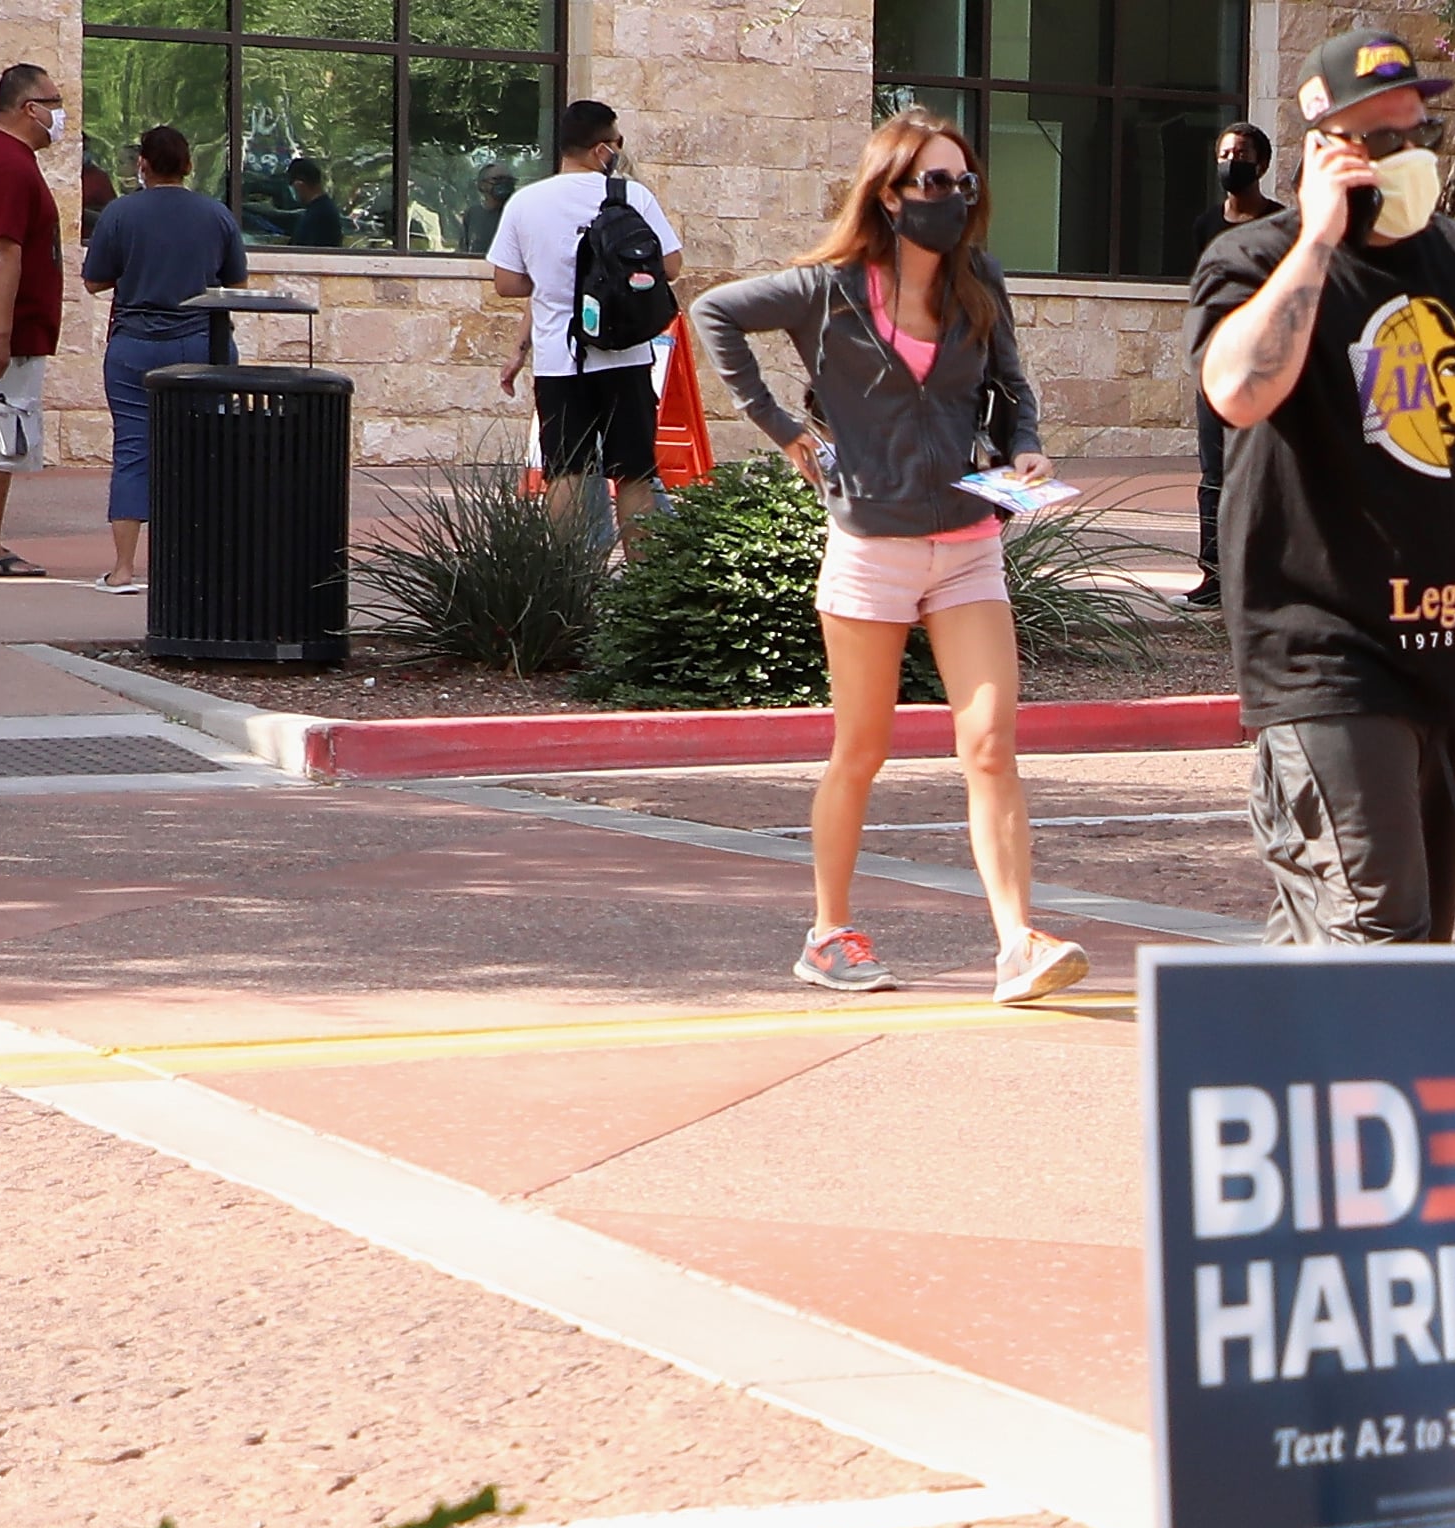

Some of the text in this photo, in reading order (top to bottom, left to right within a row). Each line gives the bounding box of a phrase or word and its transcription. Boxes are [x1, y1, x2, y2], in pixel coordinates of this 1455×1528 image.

[1274, 1424, 1345, 1468] Text
[1355, 1415, 1408, 1458] AZ
[1414, 1416, 1443, 1452] to
